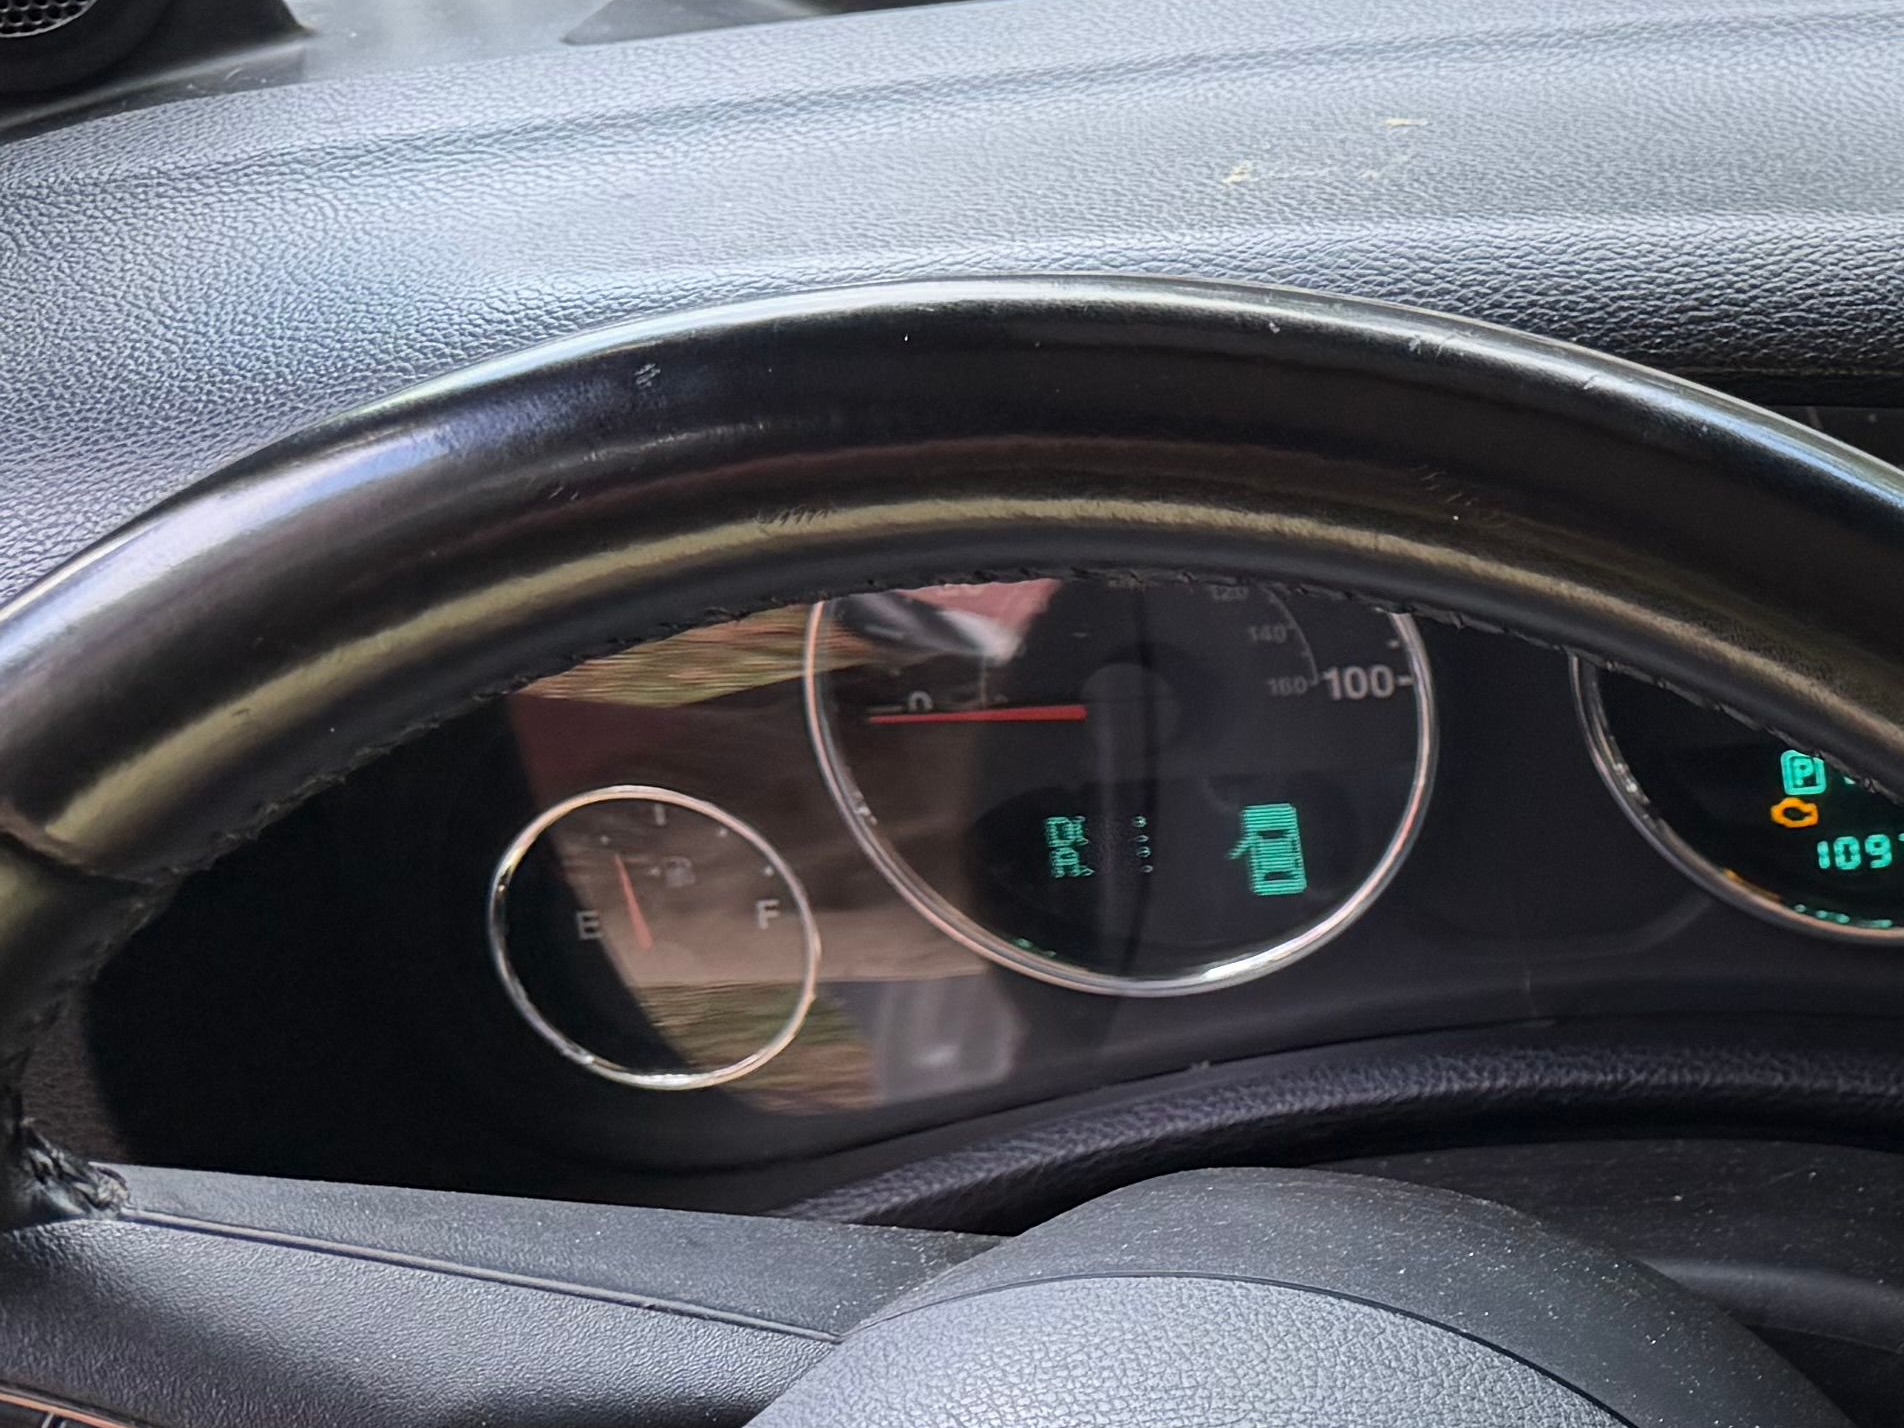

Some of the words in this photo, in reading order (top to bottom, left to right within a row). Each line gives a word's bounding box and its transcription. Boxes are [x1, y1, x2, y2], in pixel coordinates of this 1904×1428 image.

[1323, 665, 1396, 700] 100
[577, 910, 601, 941] E
[757, 899, 780, 928] F
